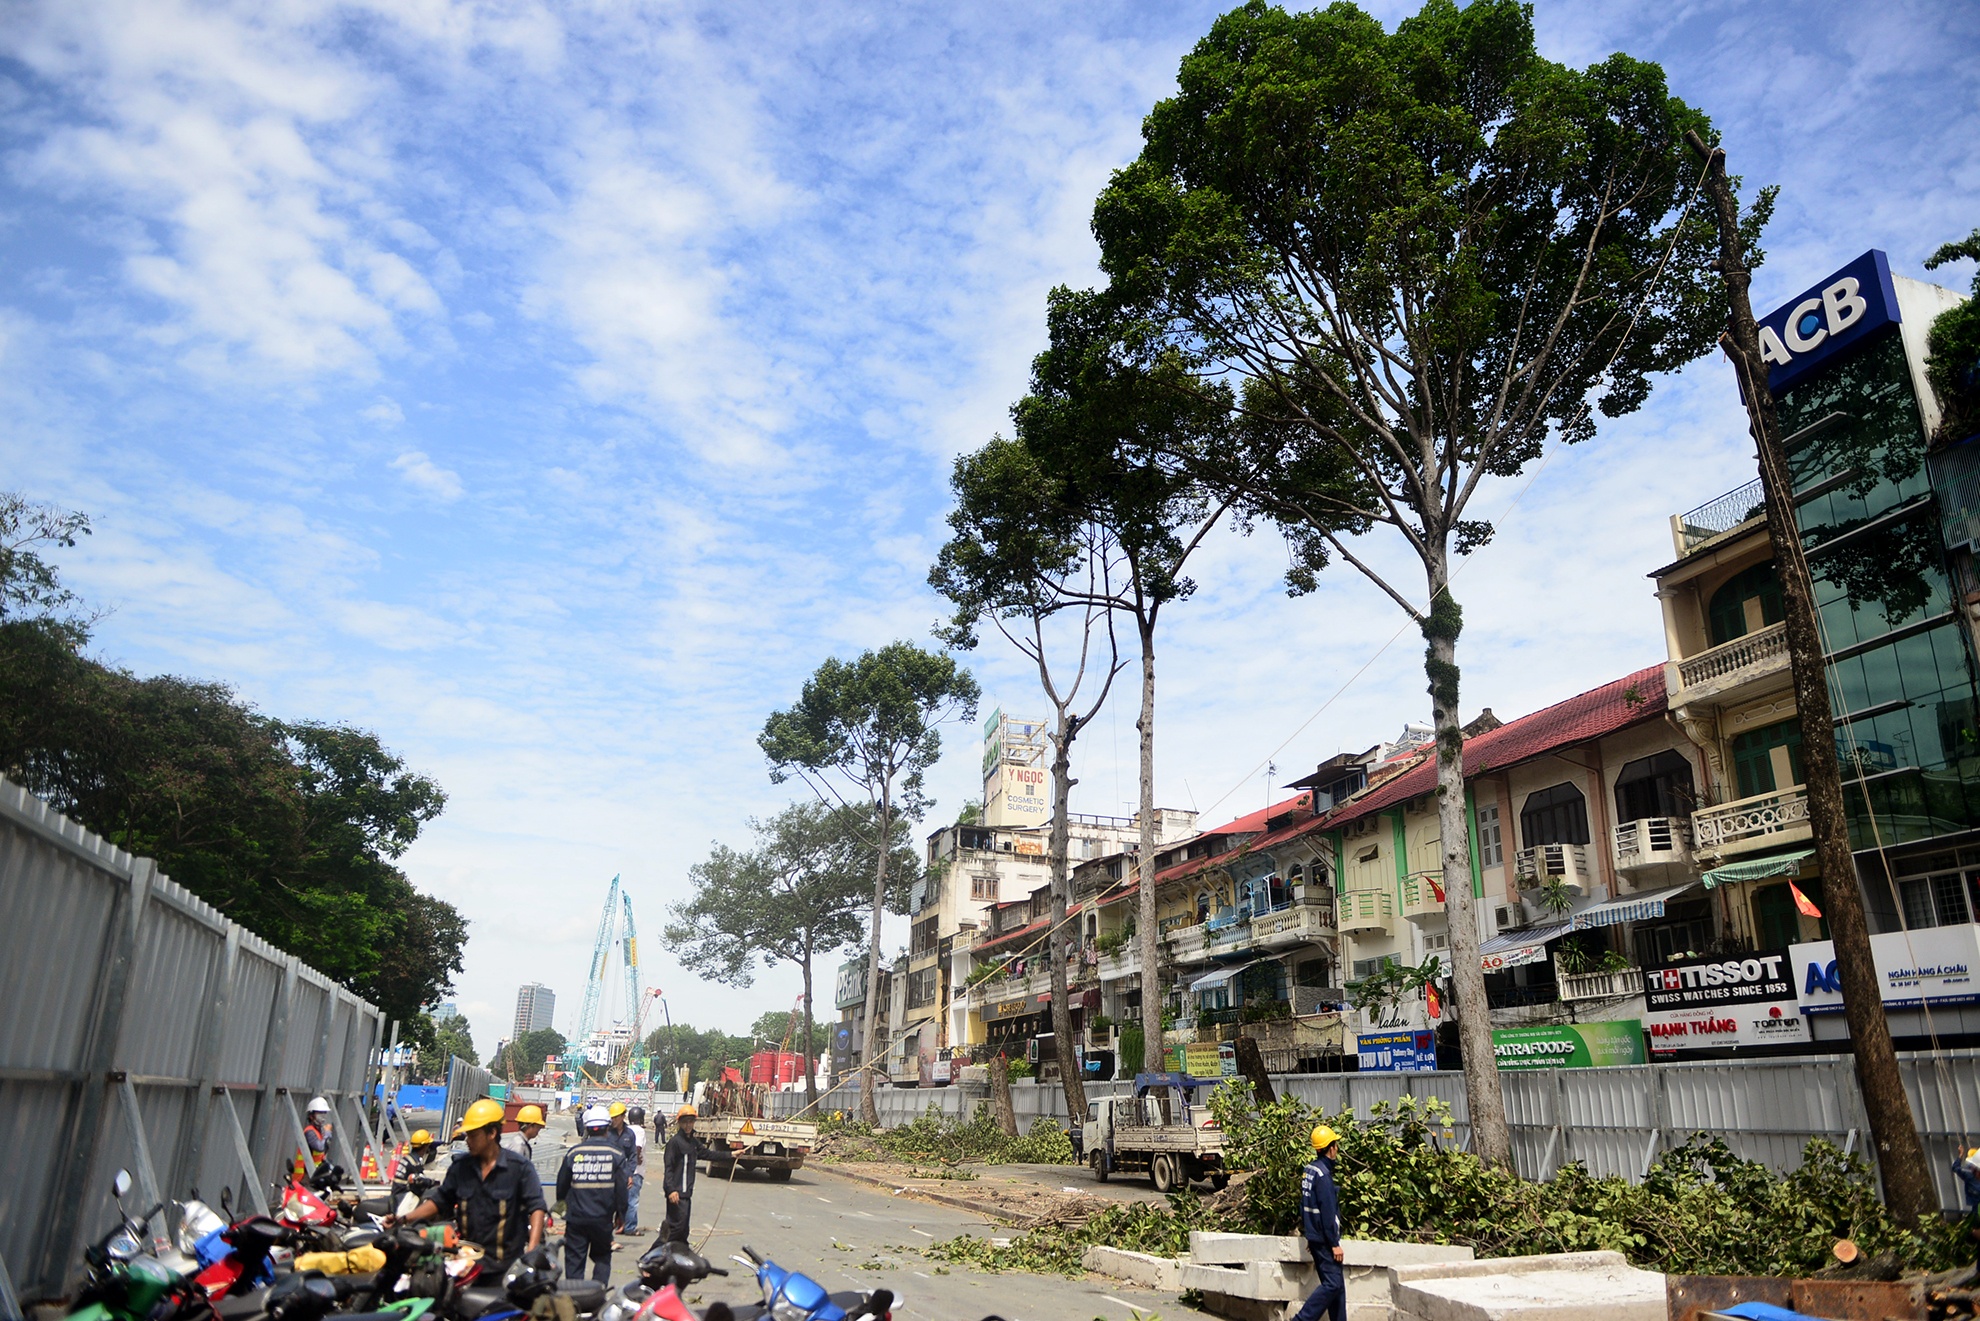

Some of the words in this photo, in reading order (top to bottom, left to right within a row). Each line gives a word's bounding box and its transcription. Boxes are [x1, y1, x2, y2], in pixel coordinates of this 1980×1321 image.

[1758, 276, 1867, 366] ACB
[1017, 769, 1043, 785] NGỌC
[1007, 795, 1044, 806] COSMETIC
[1007, 803, 1044, 814] SURGERY
[1680, 955, 1782, 988] TISSOT
[1805, 960, 1841, 995] AC
[1888, 968, 1911, 979] NGÂN
[1912, 966, 1935, 978] HÀNG
[1937, 964, 1943, 975] Á
[1944, 963, 1967, 974] CHÂU
[1651, 993, 1680, 1004] SWISS
[1683, 987, 1730, 1001] WATCHES
[1732, 984, 1763, 997] SINCE
[1765, 982, 1788, 994] 1853
[1650, 1022, 1688, 1040] MẠNH
[1494, 1040, 1575, 1056] SATRAFOODS
[1377, 1047, 1392, 1067] VŨ
[1417, 1053, 1423, 1062] LÊ
[1425, 1053, 1434, 1063] LỢI
[572, 1162, 583, 1173] CÔNG
